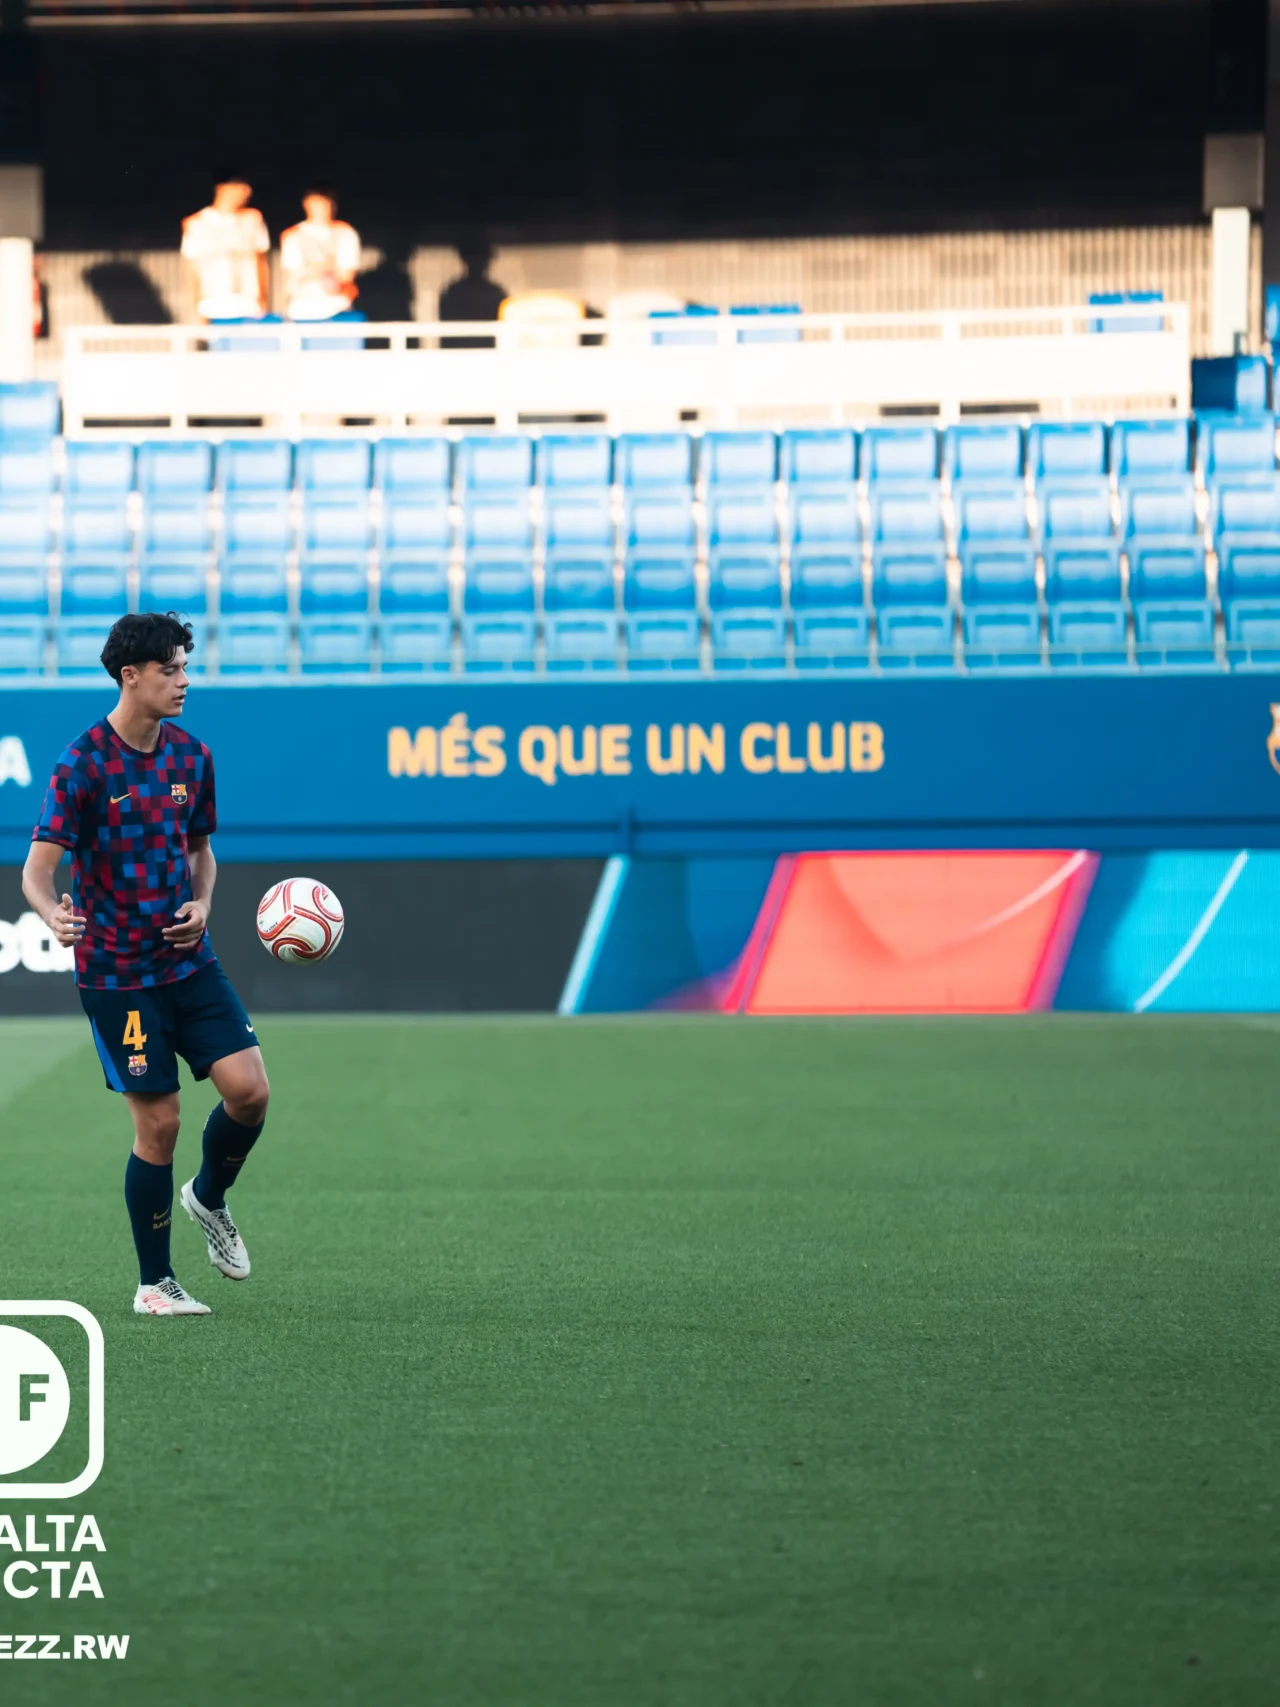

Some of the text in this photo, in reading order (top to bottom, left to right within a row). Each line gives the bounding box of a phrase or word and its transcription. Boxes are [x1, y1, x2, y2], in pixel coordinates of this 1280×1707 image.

[387, 712, 885, 786] MÉS QUE UN CLUB
[122, 1010, 148, 1051] 4
